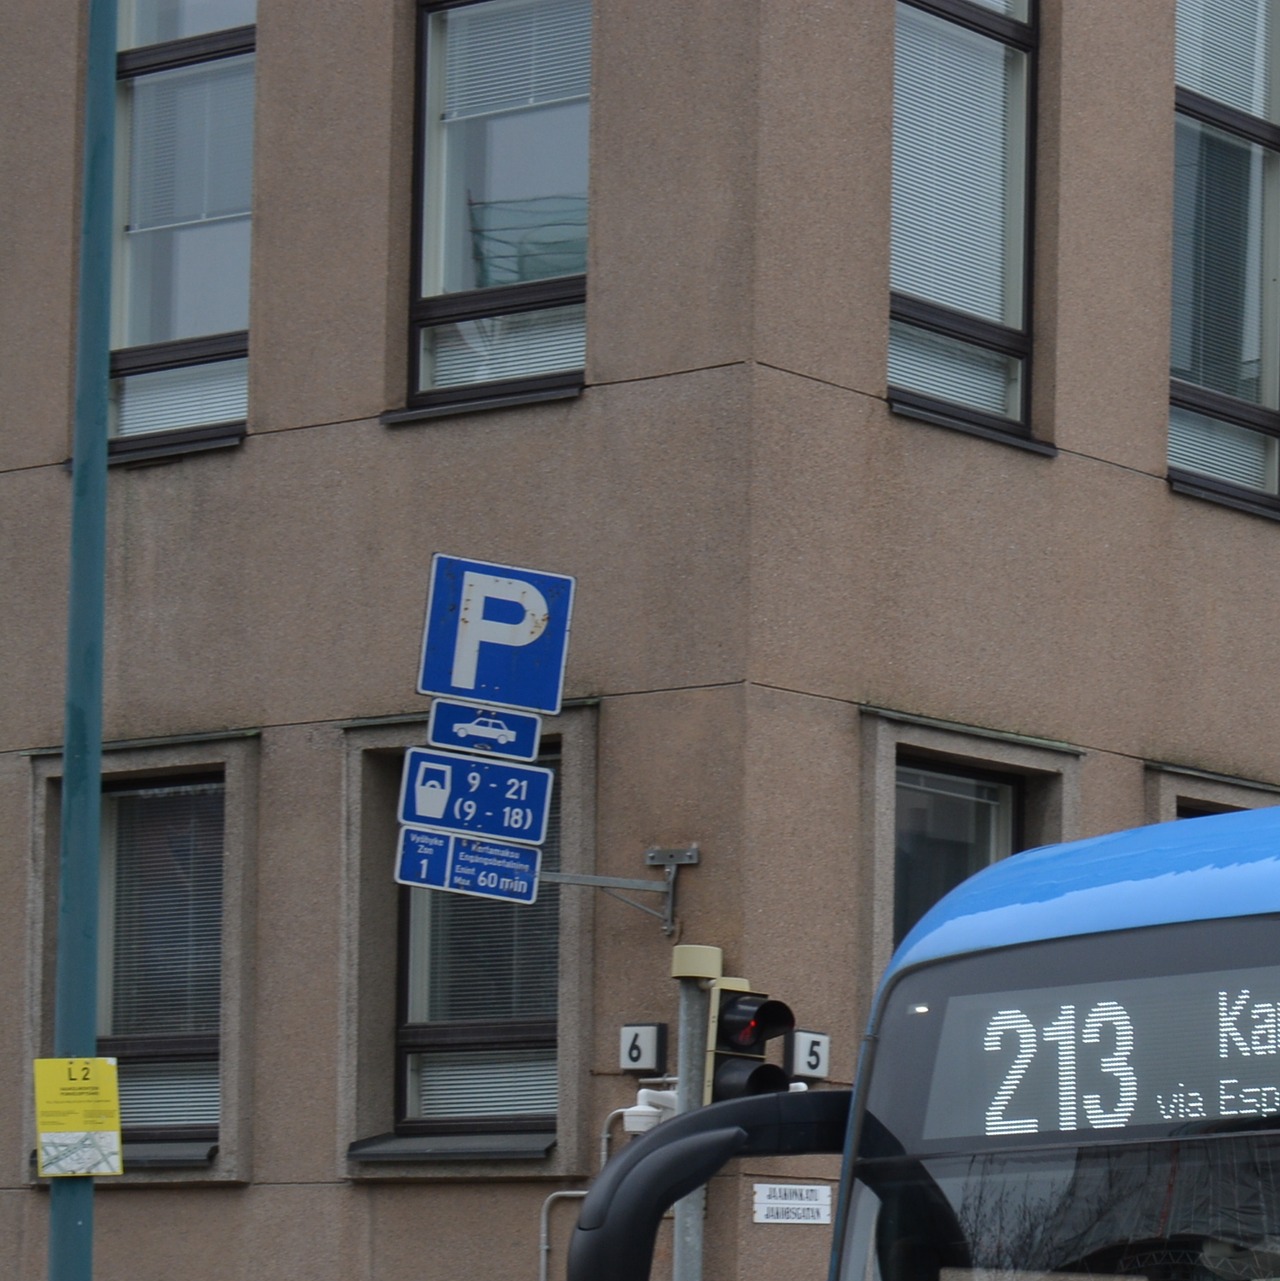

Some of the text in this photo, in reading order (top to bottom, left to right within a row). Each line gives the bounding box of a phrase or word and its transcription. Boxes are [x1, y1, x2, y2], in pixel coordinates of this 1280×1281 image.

[451, 571, 549, 690] P
[467, 772, 481, 792] 9
[505, 778, 529, 801] 21
[453, 797, 477, 821] (9
[502, 806, 534, 831] 18)
[420, 859, 429, 880] 1
[477, 871, 528, 894] 60 min
[628, 1033, 642, 1062] 6
[806, 1040, 821, 1070] 5
[68, 1067, 91, 1081] L 2
[983, 1001, 1138, 1136] 213
[1156, 1083, 1206, 1120] via
